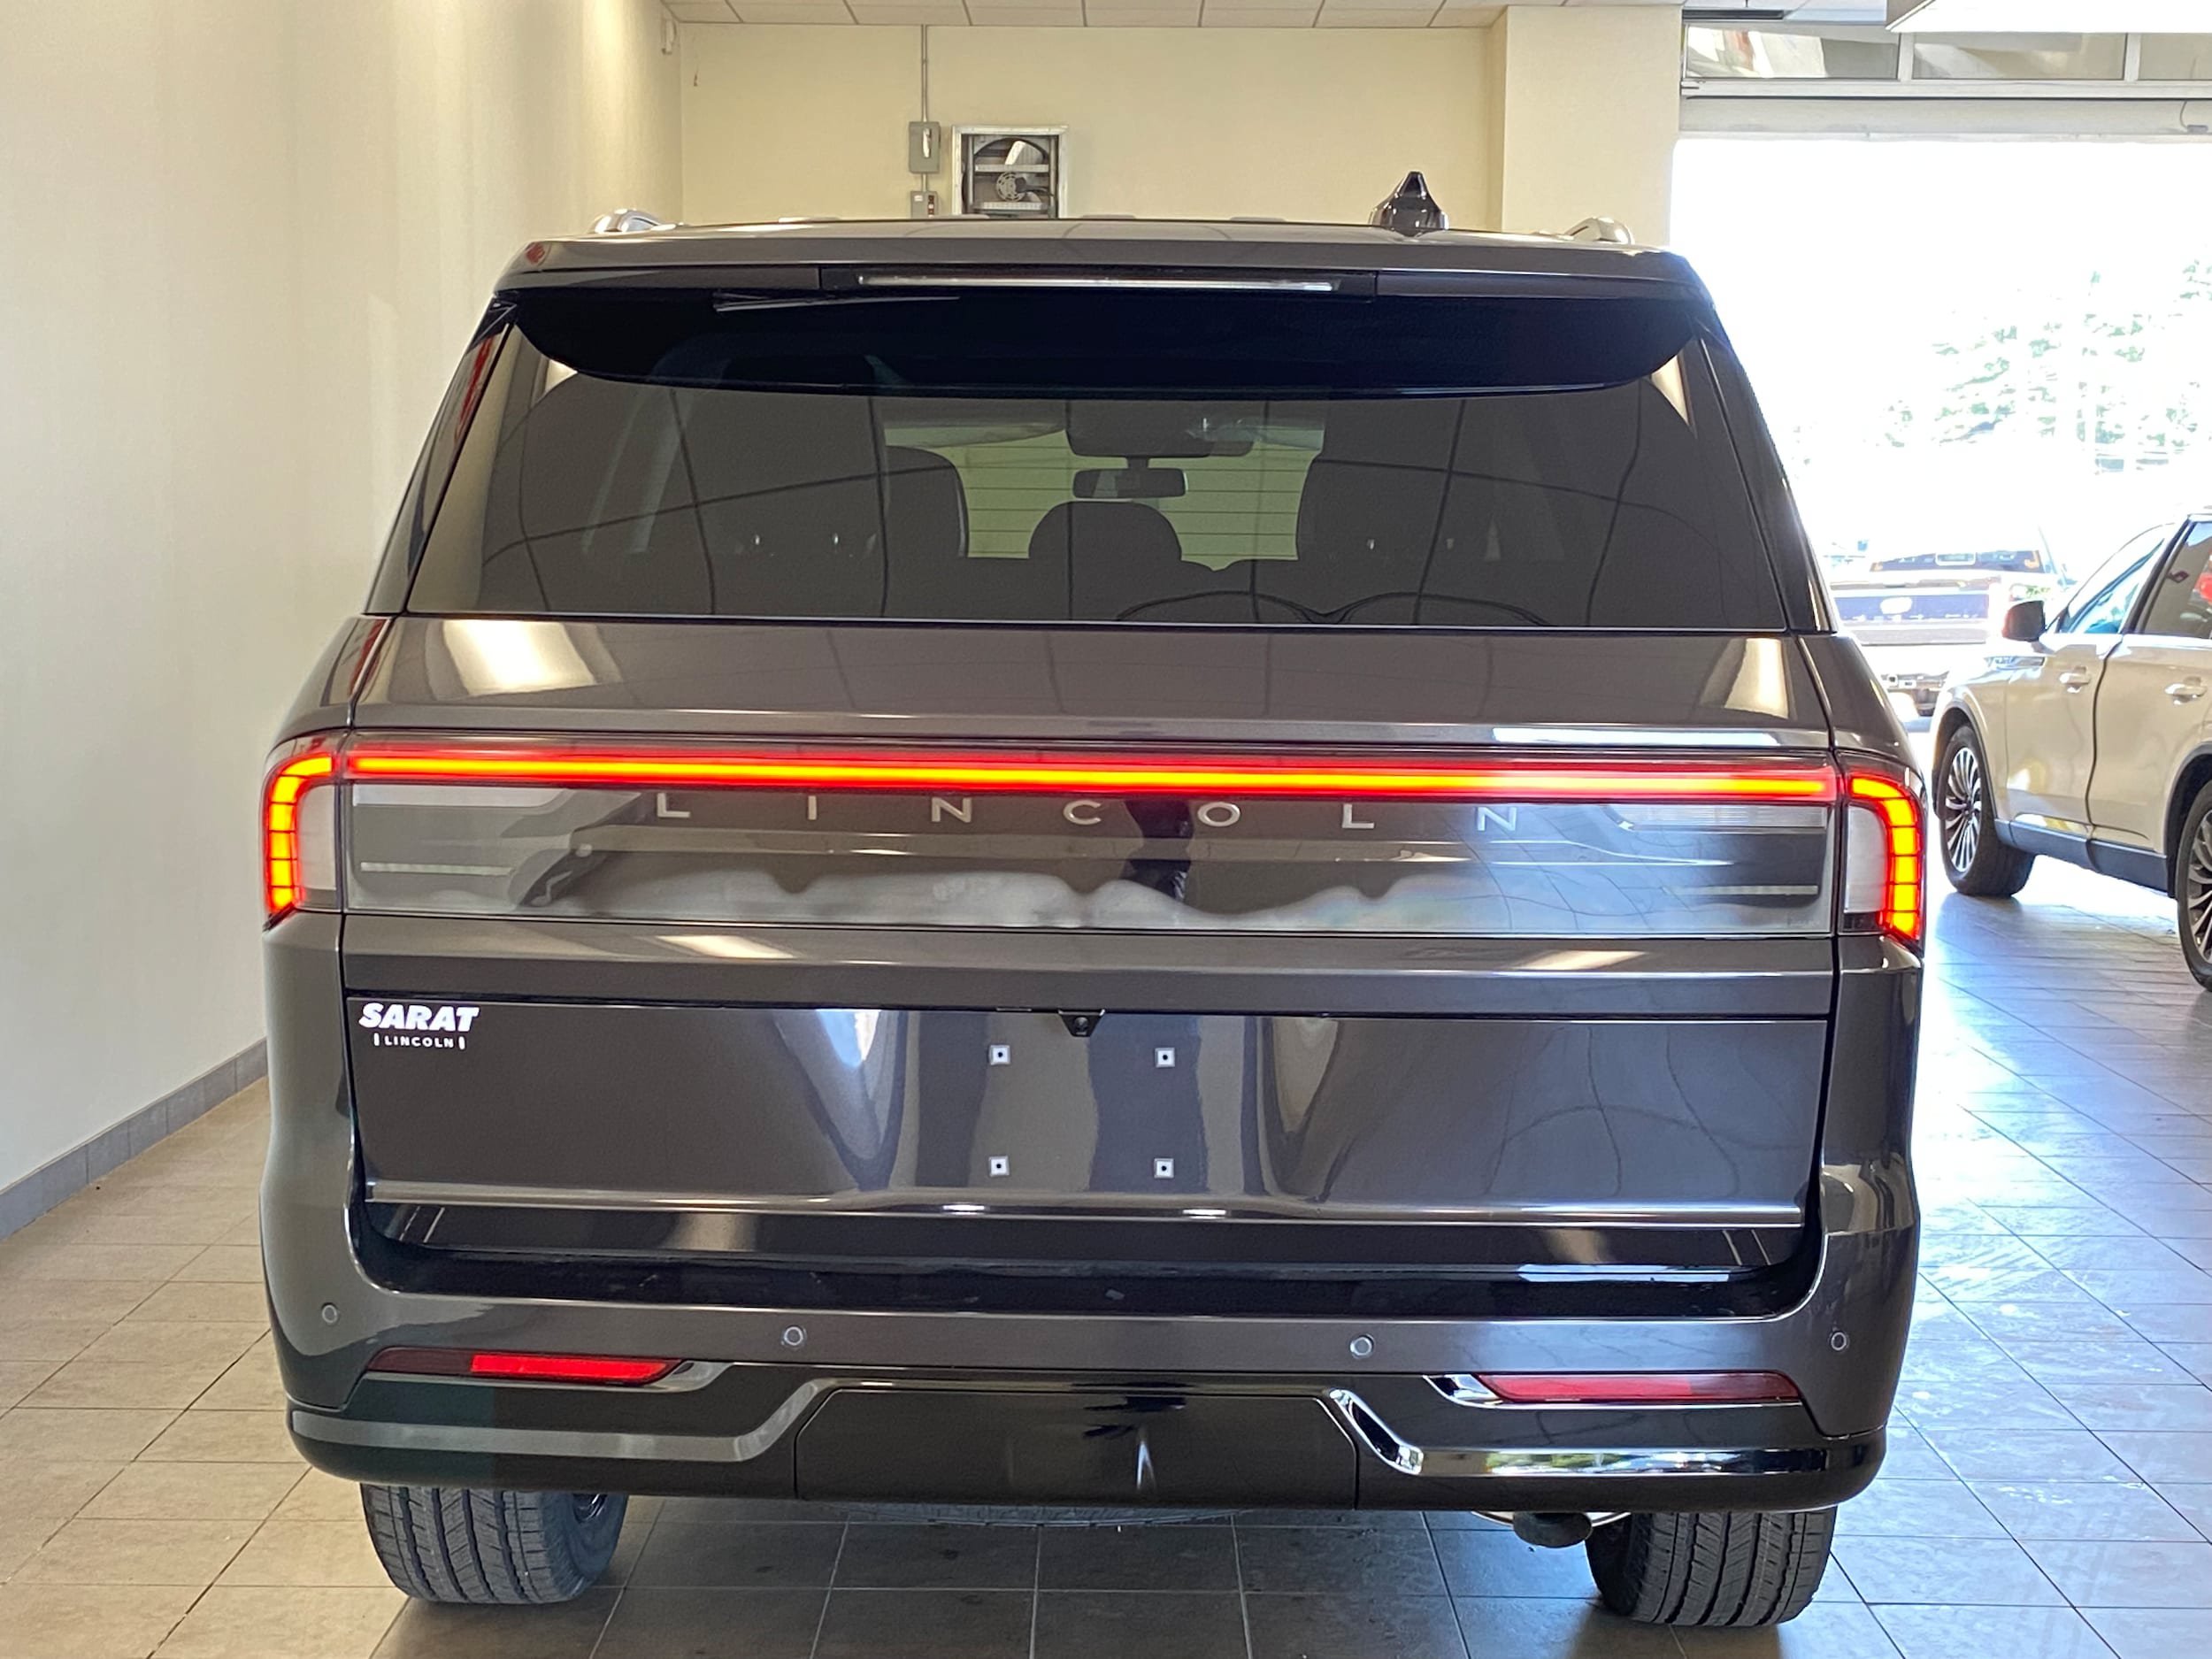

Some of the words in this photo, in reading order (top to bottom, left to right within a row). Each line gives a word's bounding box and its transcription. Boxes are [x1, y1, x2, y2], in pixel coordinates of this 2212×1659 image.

[657, 792, 1517, 831] LINCOLN
[358, 1002, 480, 1033] SARAT
[384, 1034, 454, 1048] LINCOLN
